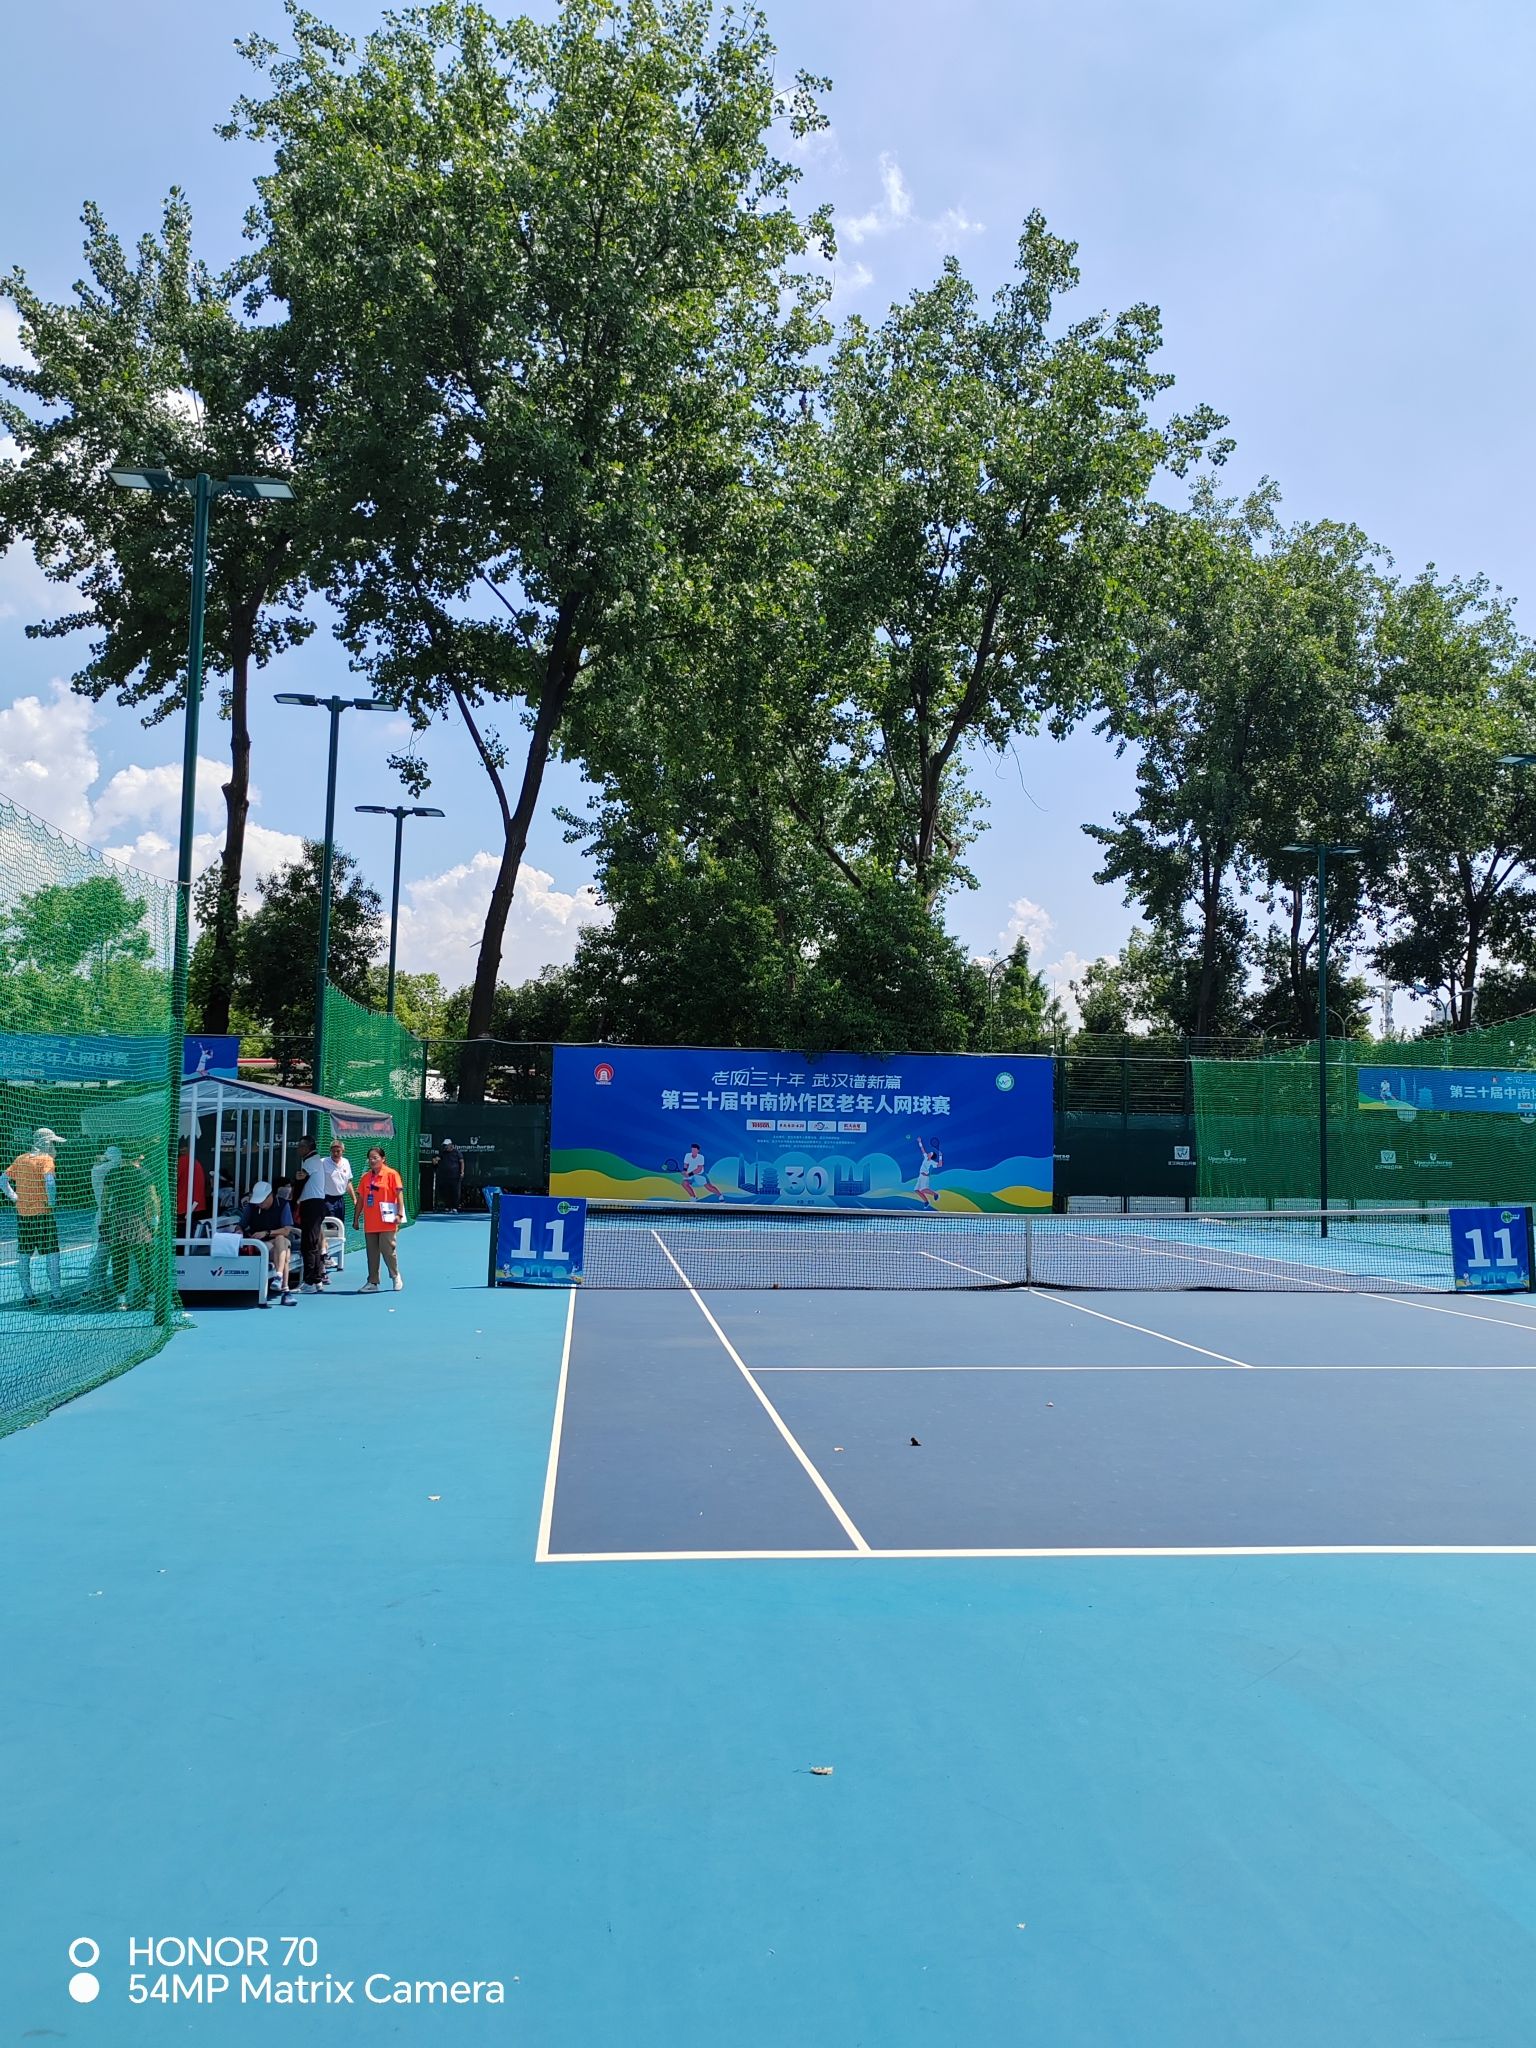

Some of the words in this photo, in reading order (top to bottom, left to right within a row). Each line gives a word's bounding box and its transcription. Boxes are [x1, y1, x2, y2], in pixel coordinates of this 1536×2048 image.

[712, 1067, 806, 1087] 老网三十年
[661, 1090, 950, 1115] 第三十届中南协作区老年人网球赛
[784, 1166, 829, 1195] 30
[511, 1218, 569, 1260] 11
[1465, 1228, 1518, 1267] 11
